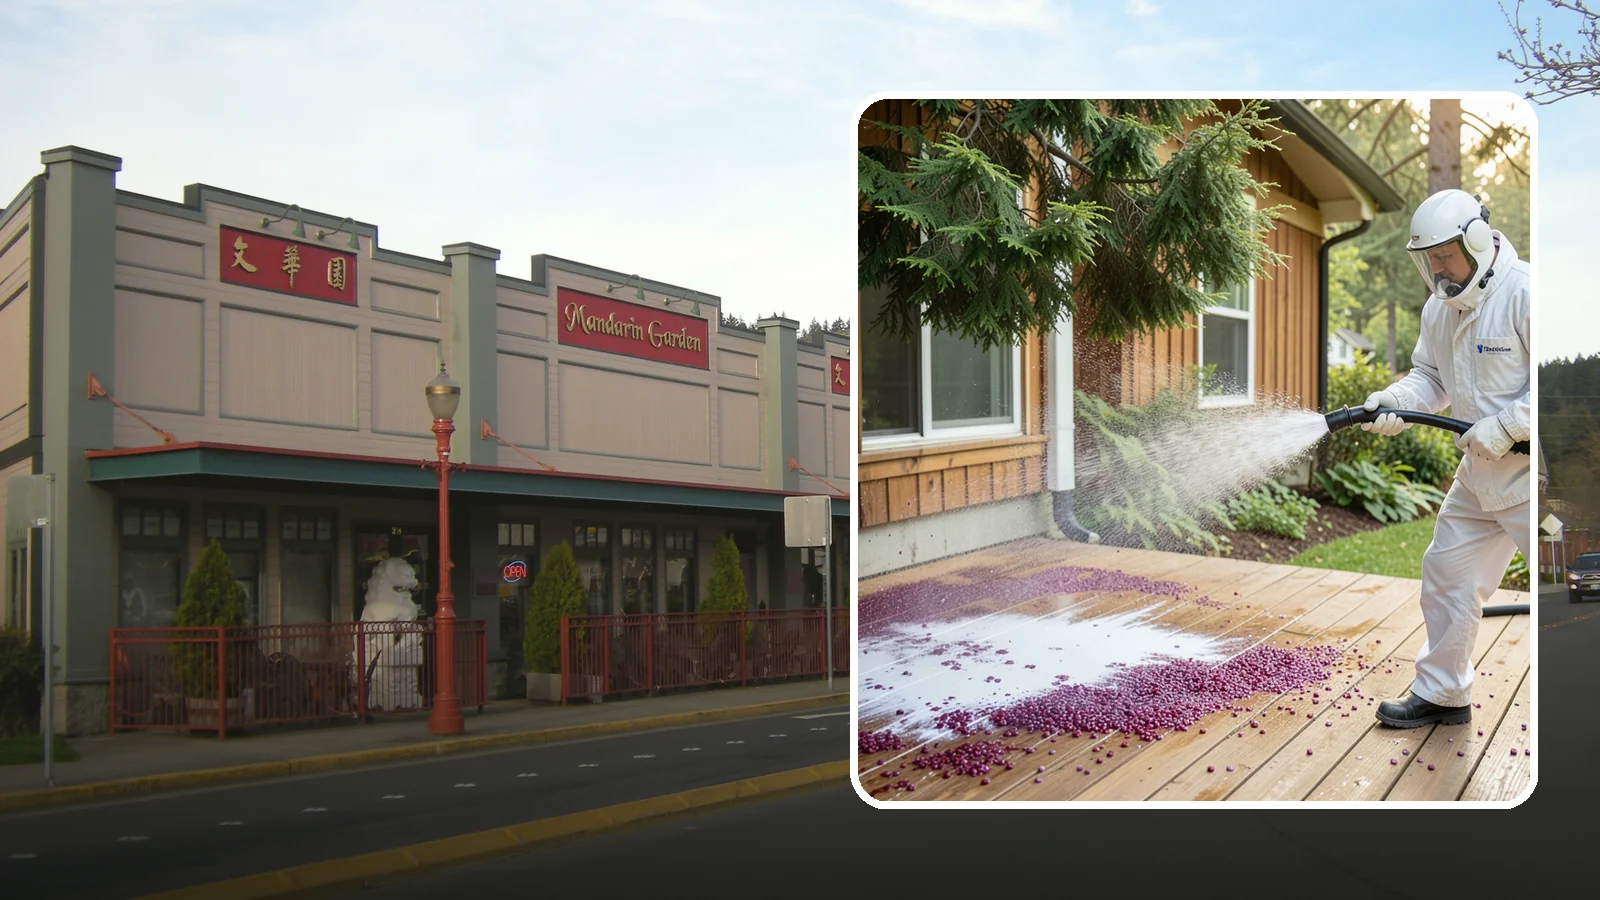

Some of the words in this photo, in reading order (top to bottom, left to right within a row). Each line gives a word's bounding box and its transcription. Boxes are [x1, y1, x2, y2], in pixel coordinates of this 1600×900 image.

[231, 235, 346, 290] 文華園
[564, 302, 644, 341] Mandarin
[647, 320, 701, 352] Garden
[503, 565, 526, 578] OPEN
